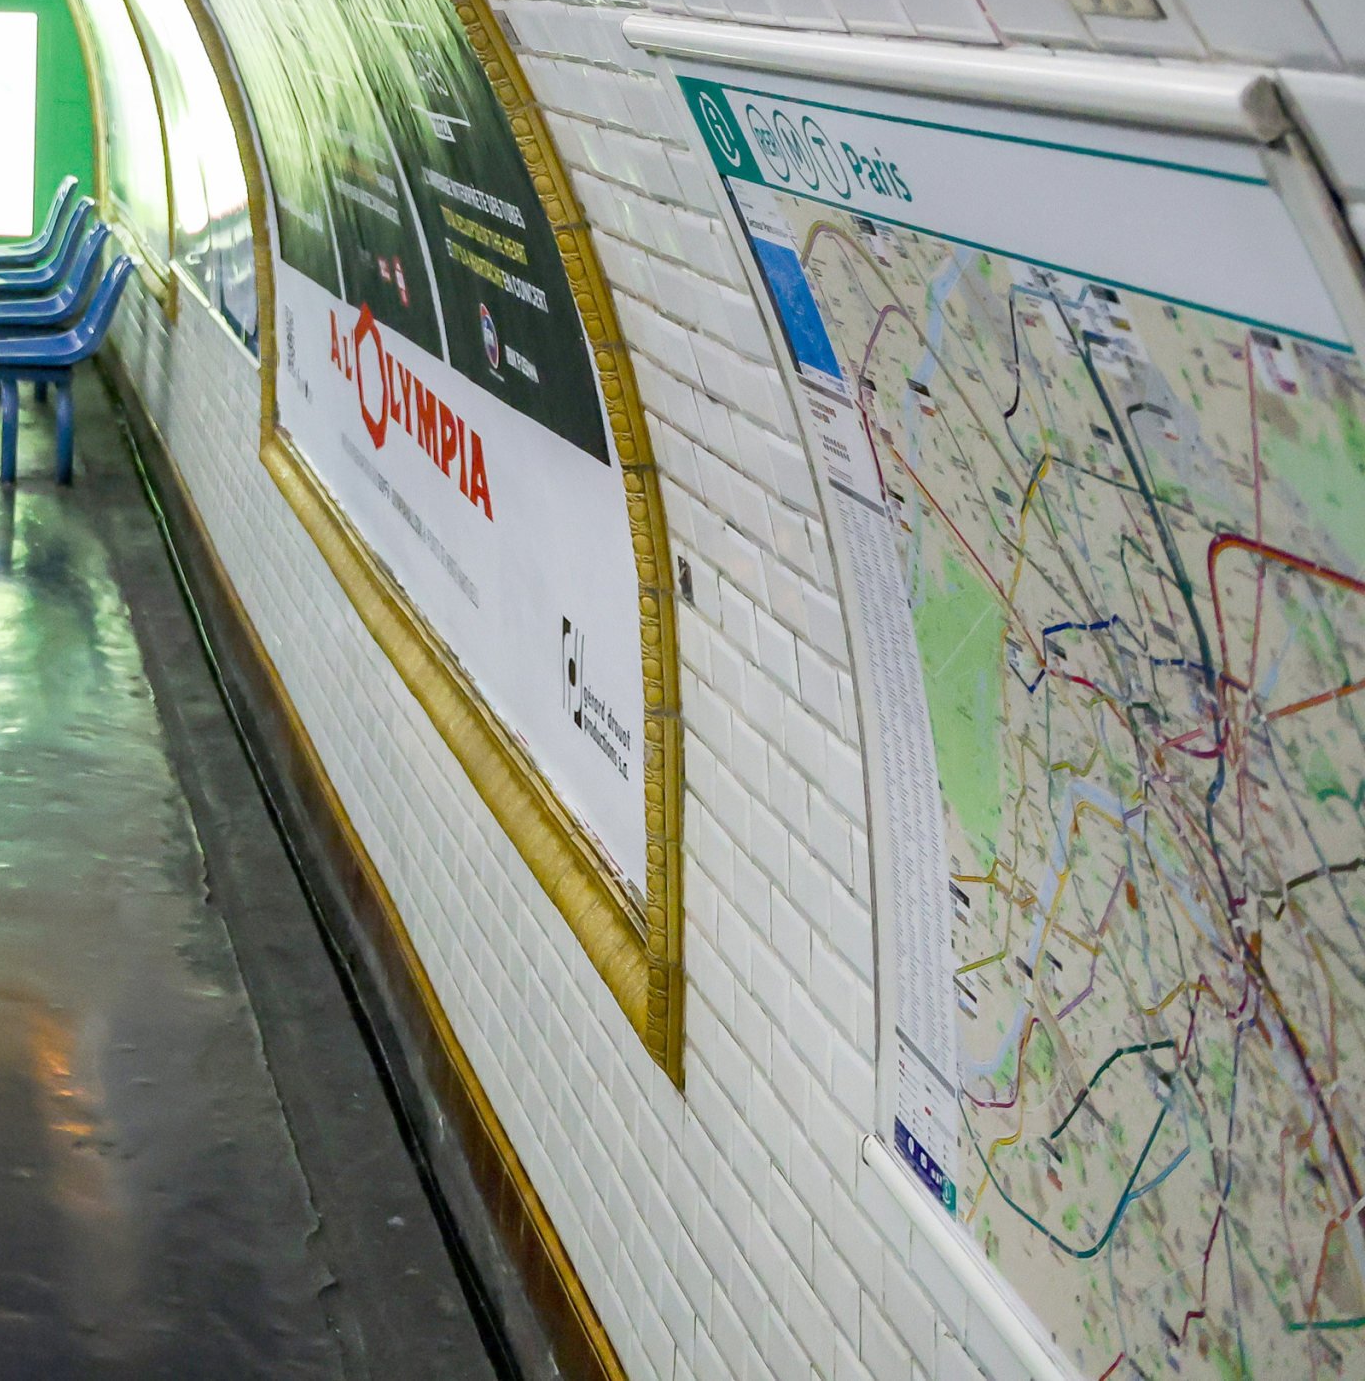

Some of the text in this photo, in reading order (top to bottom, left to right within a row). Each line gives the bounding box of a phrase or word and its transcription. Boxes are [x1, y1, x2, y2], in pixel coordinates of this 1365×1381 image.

[754, 128, 912, 202] RER M T Paris
[607, 706, 631, 751] drouot
